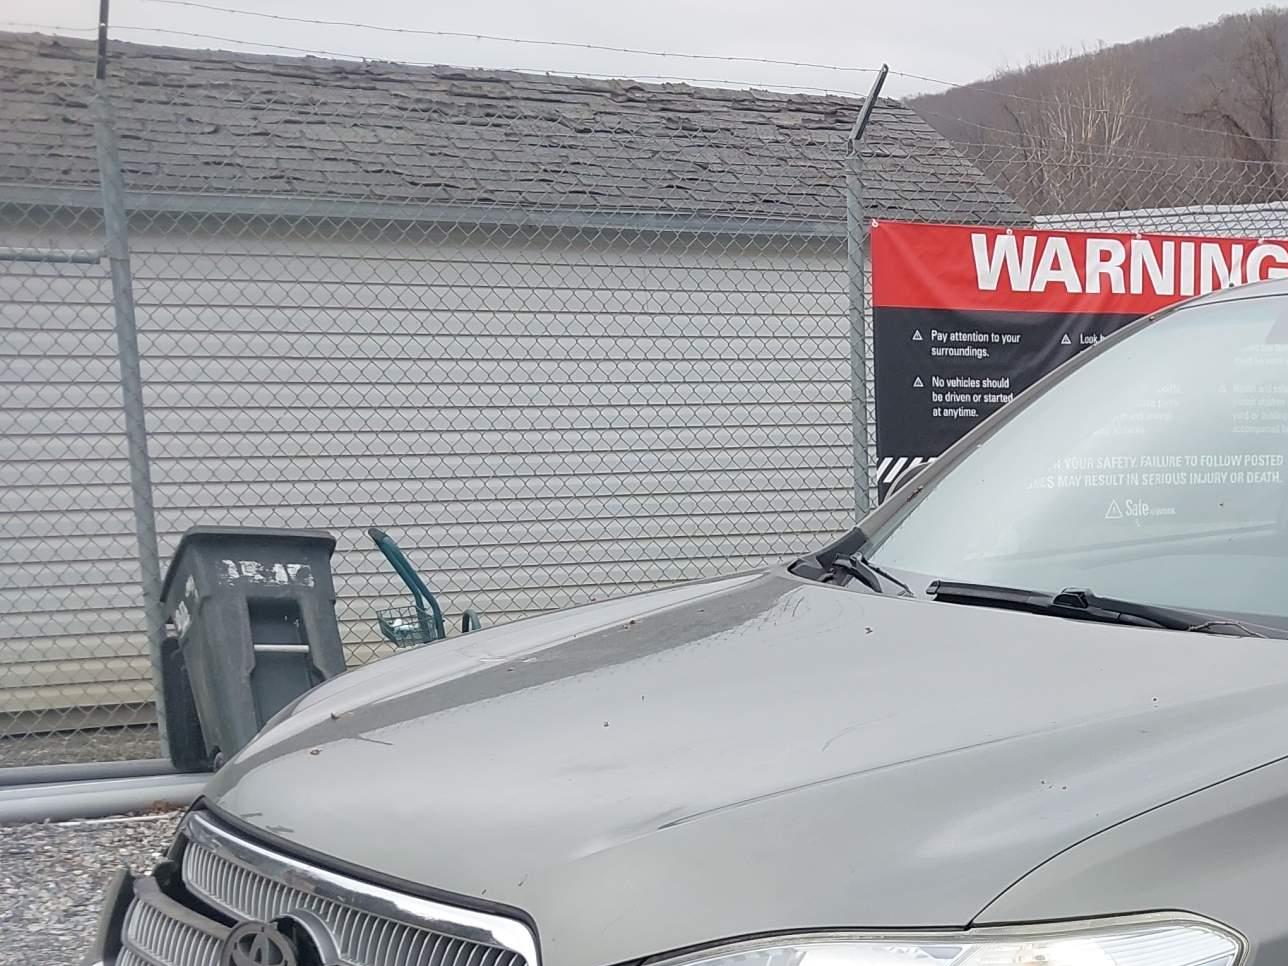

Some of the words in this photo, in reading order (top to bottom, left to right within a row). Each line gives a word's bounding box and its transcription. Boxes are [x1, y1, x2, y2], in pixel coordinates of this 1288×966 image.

[931, 329, 948, 344] Pay
[949, 331, 990, 343] attention
[991, 331, 1000, 343] to
[1001, 334, 1021, 347] your
[931, 346, 990, 360] surroundings.
[932, 376, 945, 388] No
[946, 376, 981, 388] vehicles
[982, 377, 1010, 388] should
[932, 391, 943, 402] be
[944, 391, 971, 403] driven
[972, 393, 982, 403] or
[983, 392, 1014, 404] started
[932, 407, 942, 417] at
[943, 407, 979, 419] anytime.
[1064, 457, 1094, 470] YOUR
[1140, 455, 1183, 468] FAILURE
[1184, 455, 1198, 467] TO
[1200, 454, 1242, 467] FOLLOW
[1244, 453, 1285, 466] POSTED
[1058, 474, 1082, 488] MAY
[1084, 473, 1125, 487] RESULT
[1126, 473, 1140, 486] IN
[1141, 472, 1187, 485] SERIOUS
[1189, 471, 1228, 485] INJURY
[1230, 471, 1245, 484] OR
[1125, 499, 1150, 517] Safe
